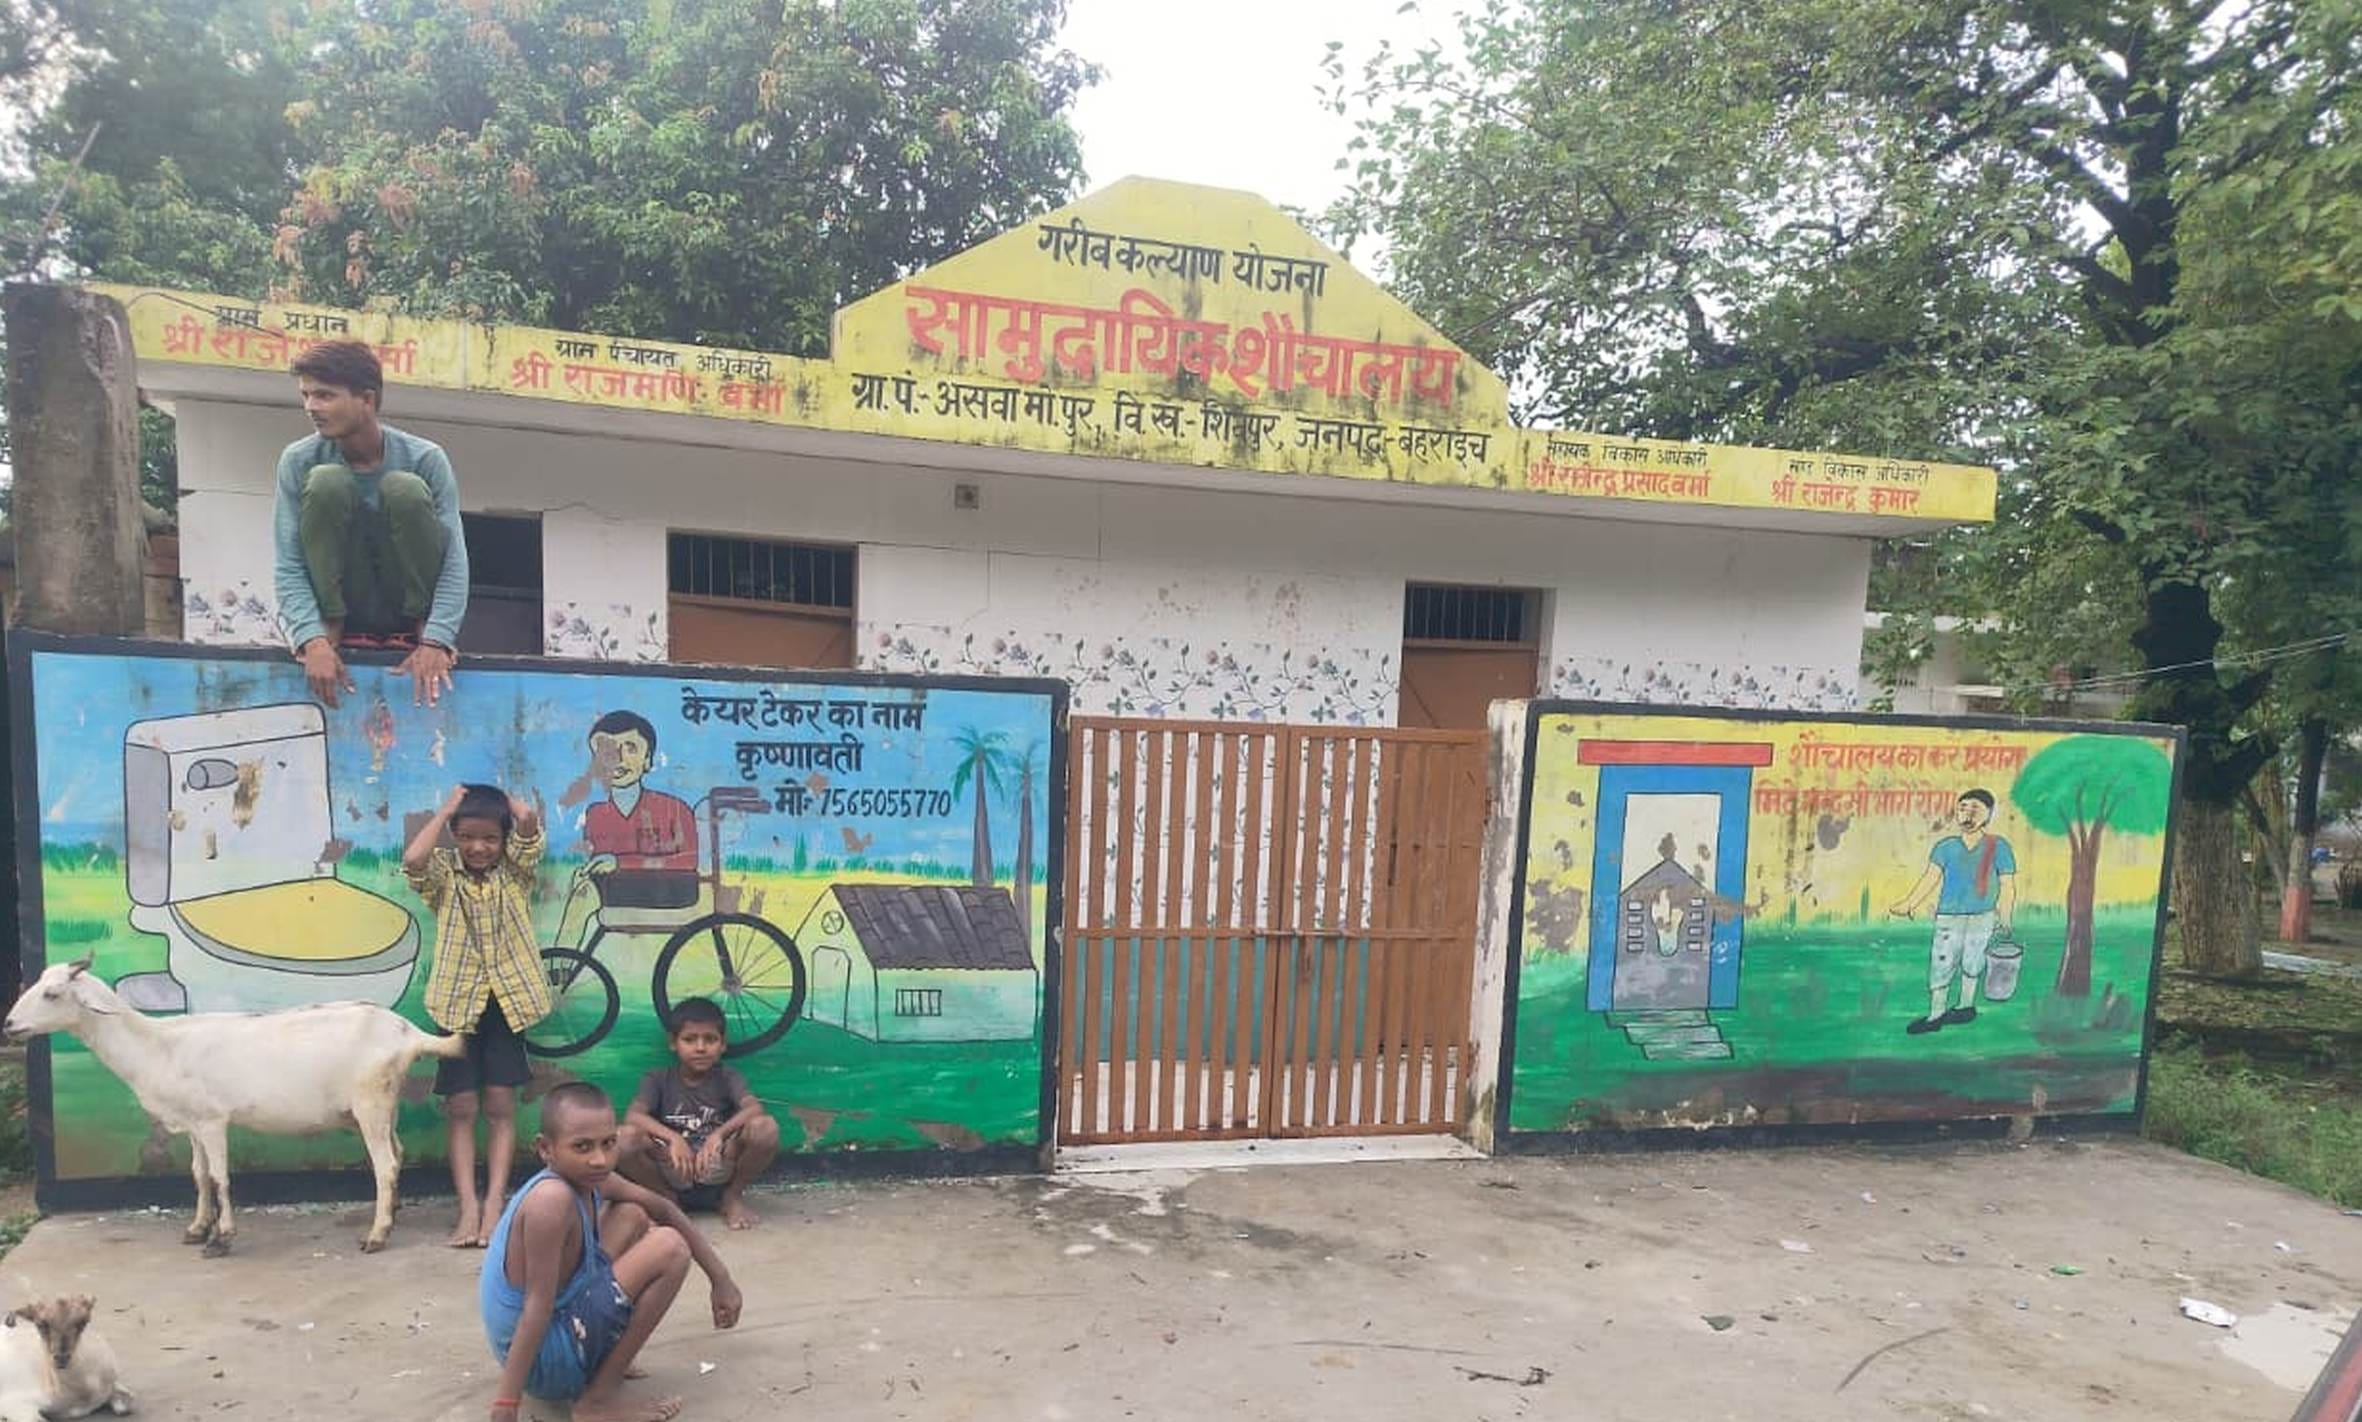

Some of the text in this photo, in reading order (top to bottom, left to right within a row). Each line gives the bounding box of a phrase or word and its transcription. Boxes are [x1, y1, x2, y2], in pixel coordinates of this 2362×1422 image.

[1116, 235, 1223, 285] कल्याण
[1232, 243, 1329, 297] योजना
[163, 314, 206, 355] श्री
[283, 311, 349, 334] प्रधान
[555, 338, 600, 361] ग्राम
[905, 285, 1462, 408] सामुदायिक शौचालय
[511, 350, 554, 390] श्री
[1771, 474, 1796, 504] श्री
[1869, 486, 1920, 514] कुमार
[681, 687, 927, 733] केयर टेकर का नाम
[735, 732, 864, 779] कृष्णावती
[1896, 745, 1925, 769] का
[820, 787, 951, 817] 7565055770
